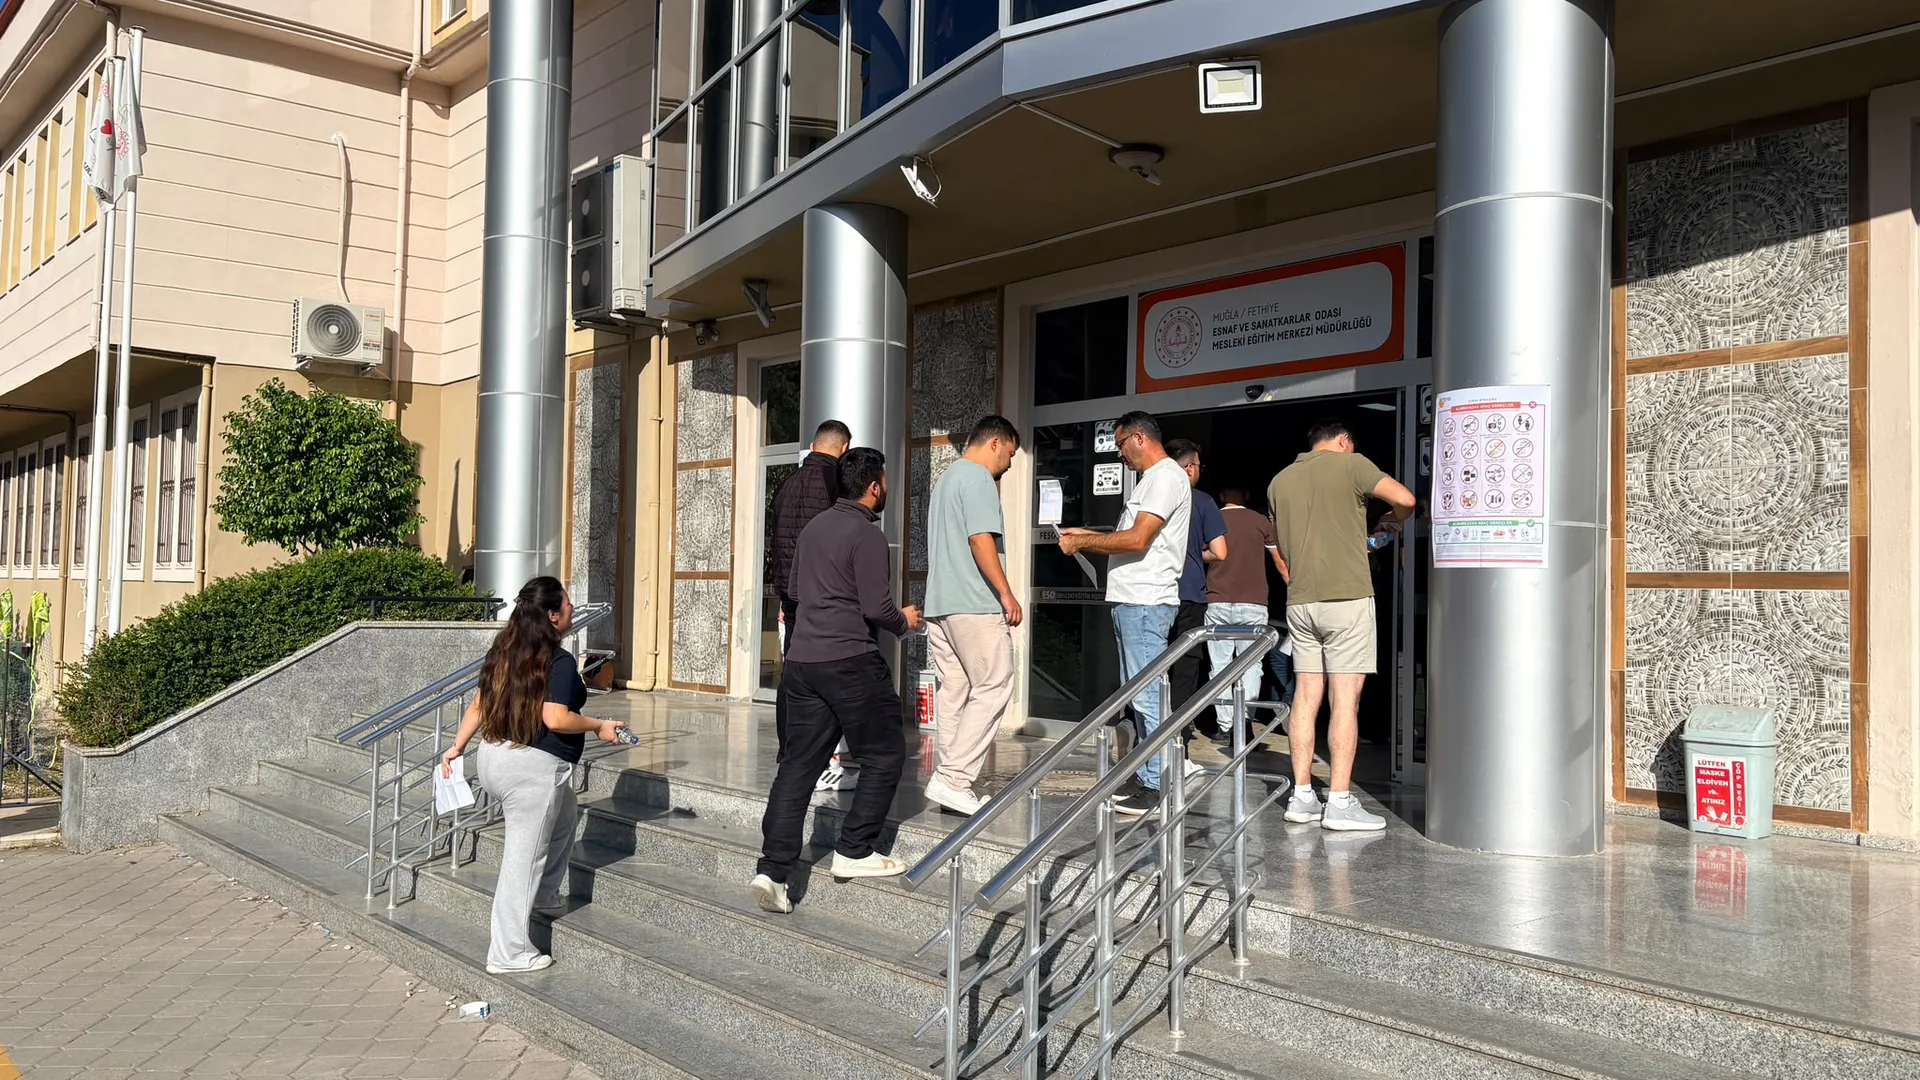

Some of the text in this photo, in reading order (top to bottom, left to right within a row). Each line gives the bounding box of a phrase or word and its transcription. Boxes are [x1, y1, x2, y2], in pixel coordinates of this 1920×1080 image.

[1212, 308, 1239, 323] MUĞLA
[1247, 302, 1279, 317] FETHİYE
[1212, 307, 1341, 337] ESNAF VE SANATKARLAR ODASI
[1212, 315, 1372, 351] MESLEKİ EĞİTİM MERKEZİ MÜDÜRLÜĞÜ
[1697, 759, 1726, 767] LÜTFEN
[1699, 769, 1726, 777] MASKE
[1696, 777, 1729, 787] ELDİVEN
[1701, 797, 1726, 806] ATINIZ
